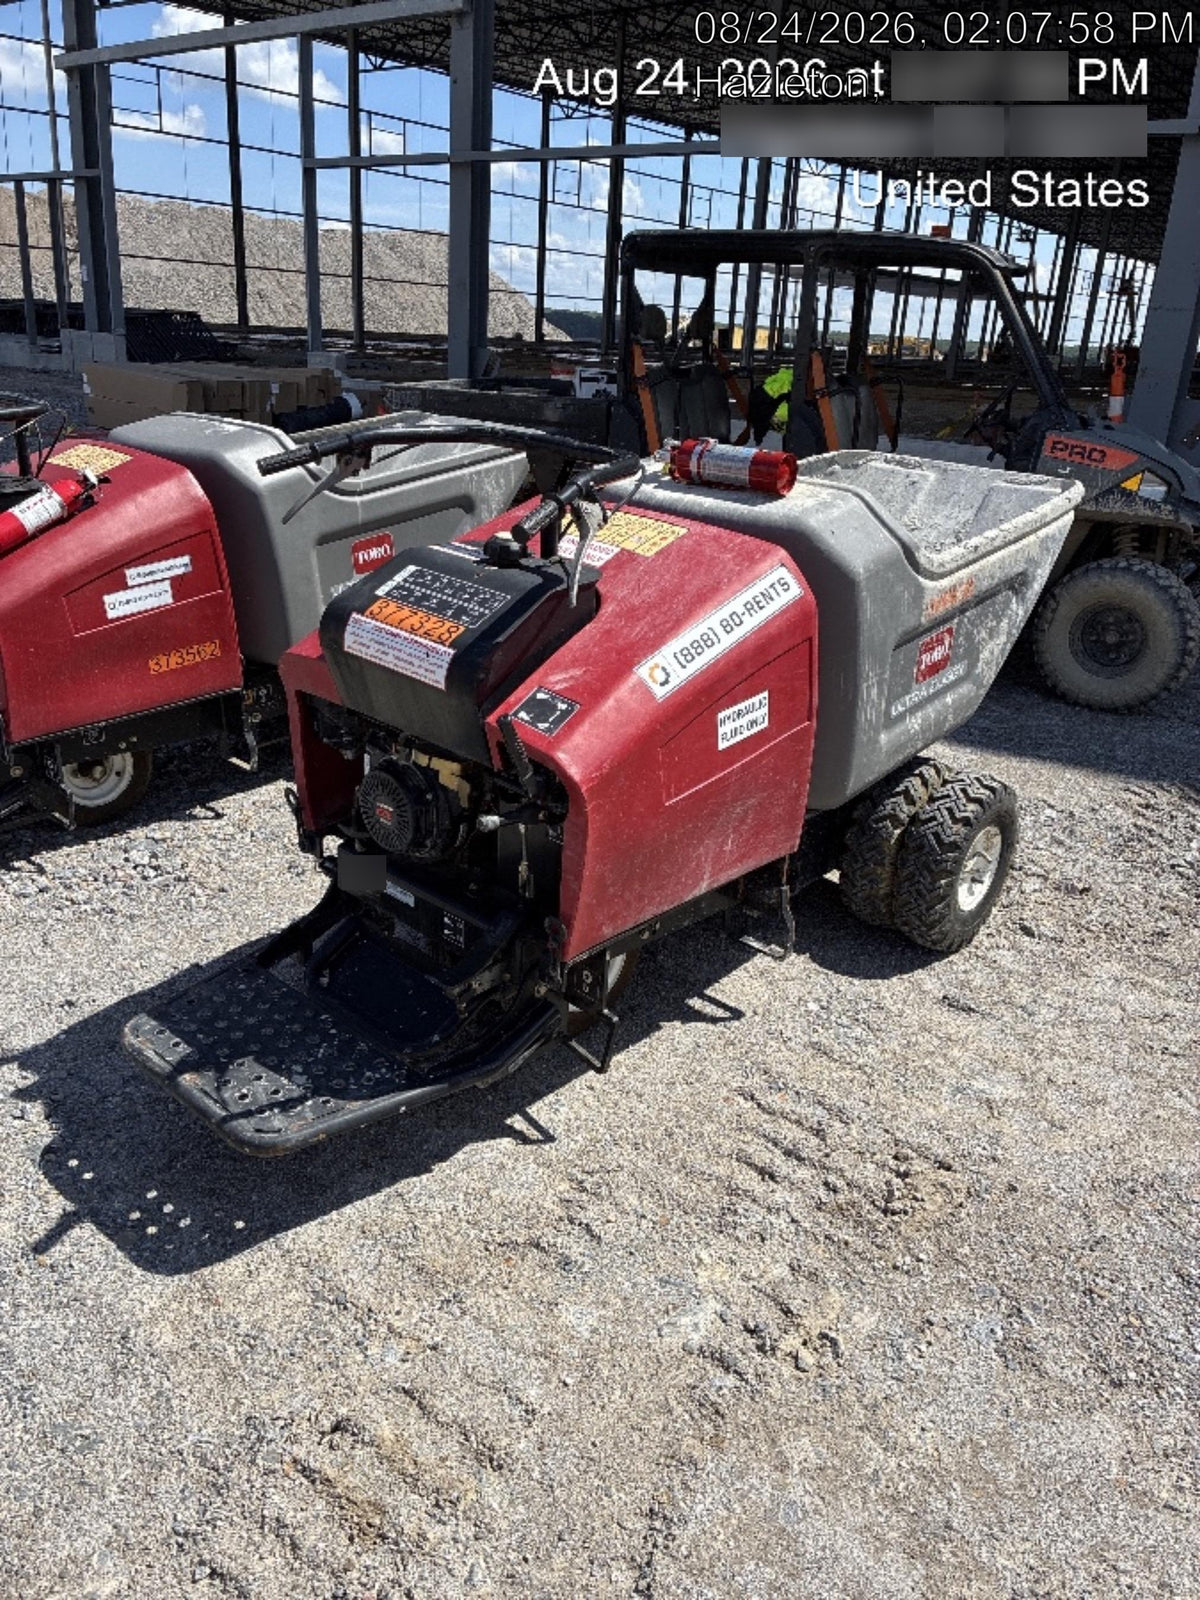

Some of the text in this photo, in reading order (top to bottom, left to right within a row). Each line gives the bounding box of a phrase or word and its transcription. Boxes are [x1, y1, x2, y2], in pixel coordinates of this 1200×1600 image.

[1050, 440, 1107, 463] PRO
[354, 543, 392, 565] TORO
[369, 600, 459, 642] 377328
[151, 641, 218, 673] 373562
[673, 627, 721, 669] (888)
[719, 696, 767, 728] HYDRAULIC
[721, 712, 767, 743] FLUID ONLY
